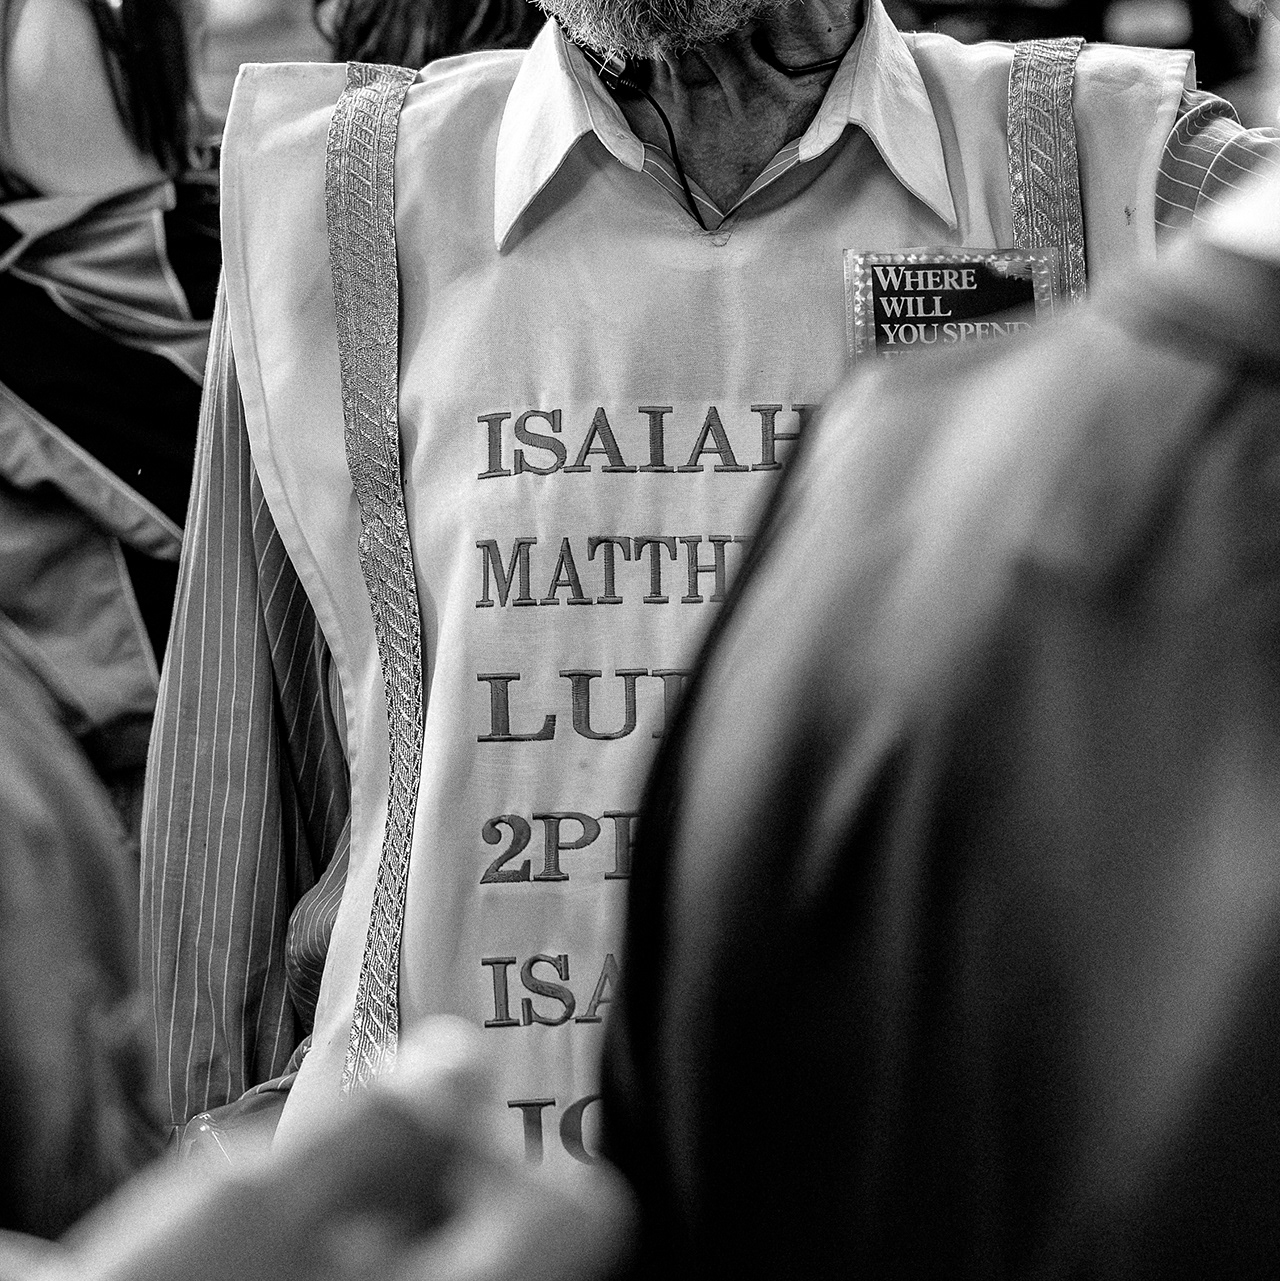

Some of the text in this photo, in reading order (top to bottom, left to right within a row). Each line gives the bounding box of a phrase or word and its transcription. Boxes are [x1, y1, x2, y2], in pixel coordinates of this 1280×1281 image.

[873, 266, 977, 291] WHERE
[880, 296, 952, 317] WILL
[881, 322, 1032, 345] YOU SPEN
[475, 534, 752, 608] MATTH
